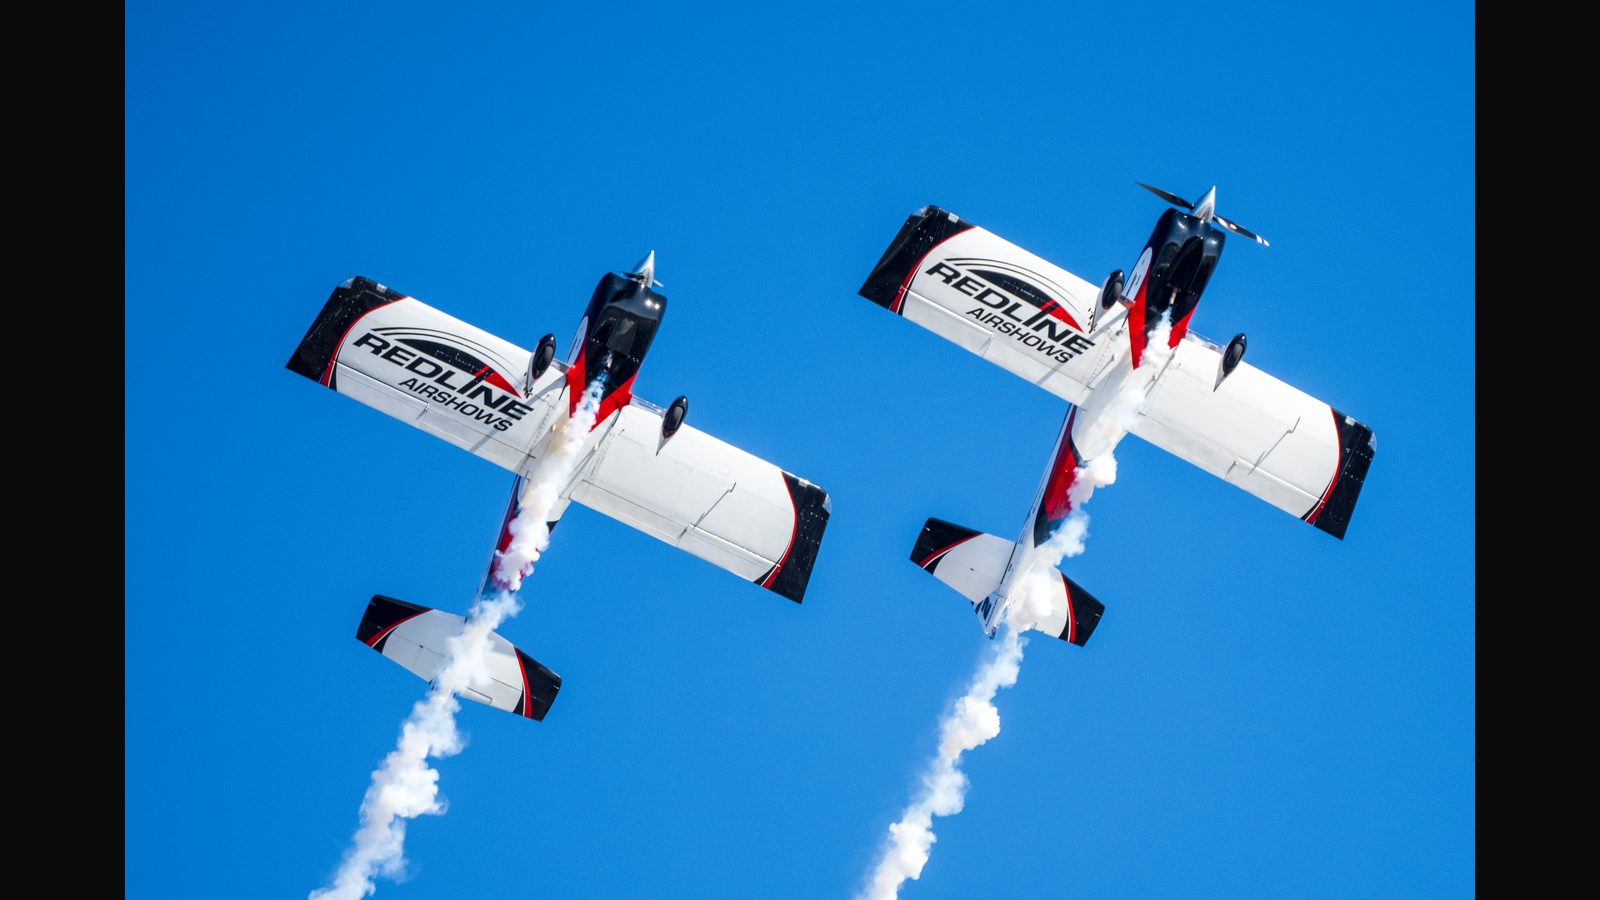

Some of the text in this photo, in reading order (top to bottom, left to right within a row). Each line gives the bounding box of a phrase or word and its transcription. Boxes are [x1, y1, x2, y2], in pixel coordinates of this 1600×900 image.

[925, 262, 1095, 355] REDLINE
[966, 307, 1074, 364] AIRSHOWS
[353, 333, 534, 421] REDLINE
[398, 378, 513, 432] AIRSHOWS
